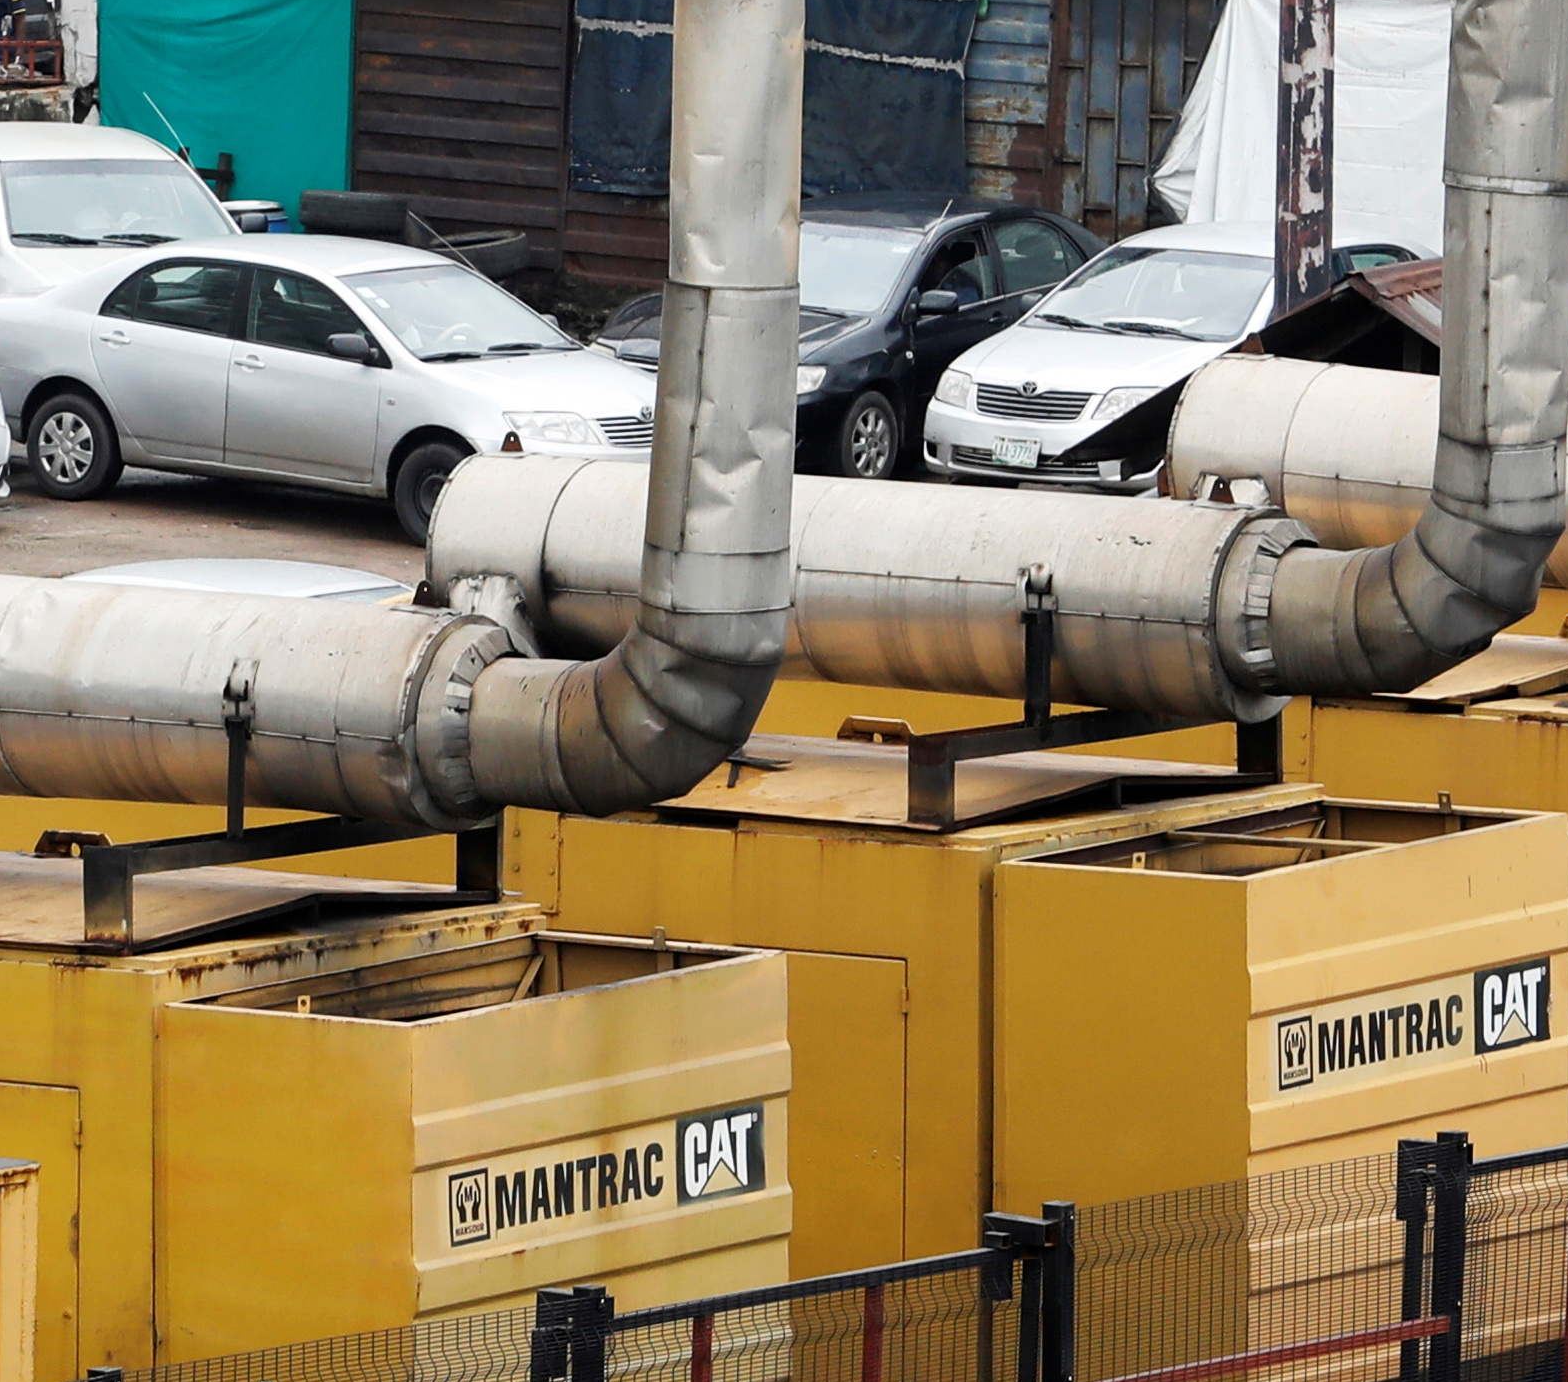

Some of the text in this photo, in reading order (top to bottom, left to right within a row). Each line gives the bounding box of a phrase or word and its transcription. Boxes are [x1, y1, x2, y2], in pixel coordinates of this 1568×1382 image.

[1318, 966, 1542, 1074] MANTRAC CAT
[495, 1112, 753, 1230] MANTRAC CAT
[455, 1222, 485, 1237] MANSOUR
